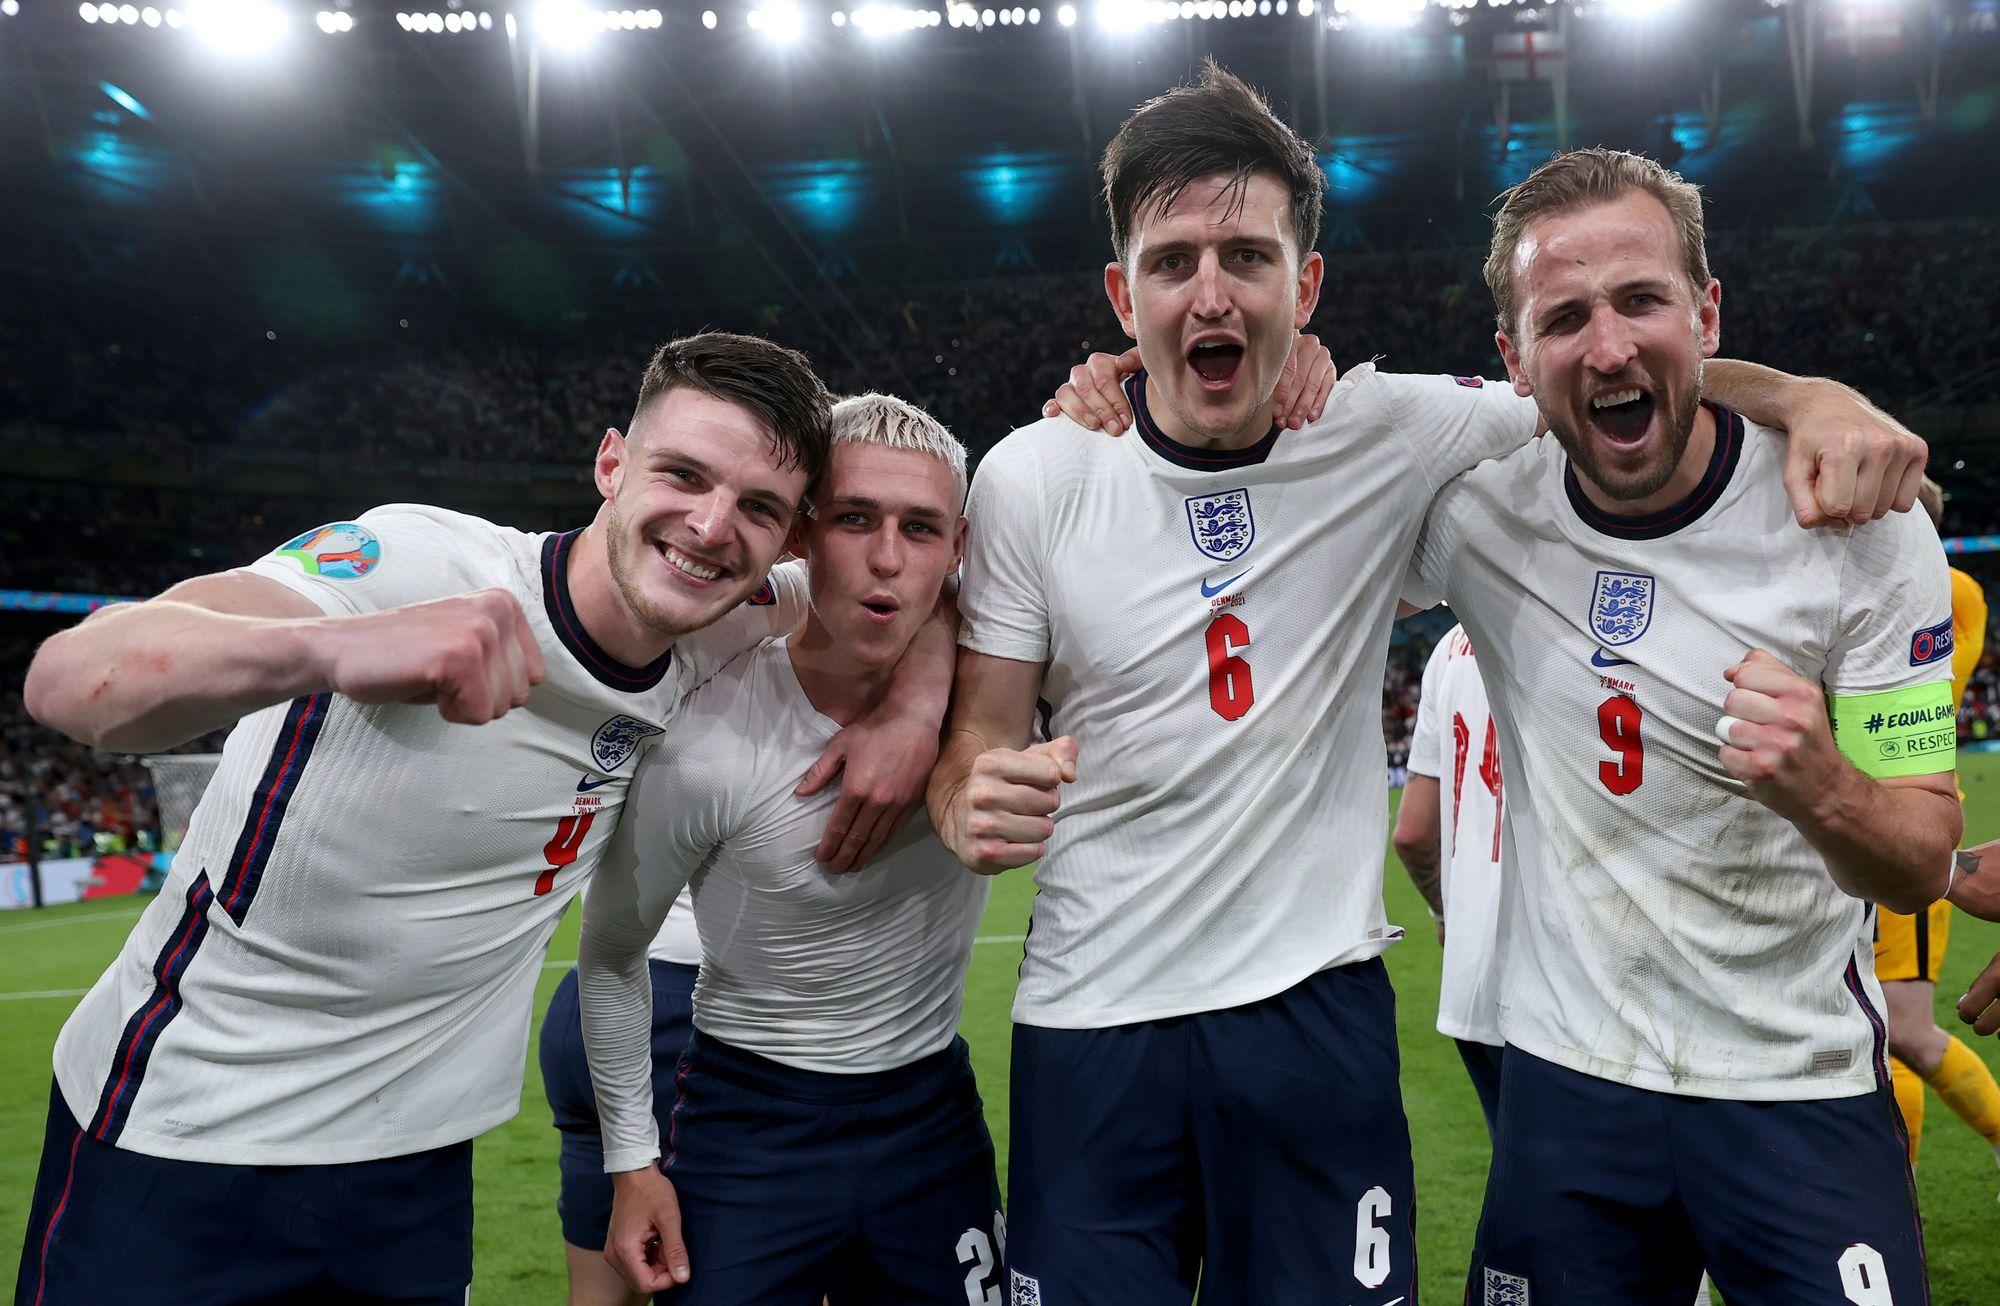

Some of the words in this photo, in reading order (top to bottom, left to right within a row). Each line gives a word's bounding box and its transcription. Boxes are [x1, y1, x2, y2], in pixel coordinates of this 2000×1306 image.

[1205, 613, 1255, 722] 6
[1597, 694, 1644, 796] 9
[1907, 731, 1955, 753] RESPECT
[534, 812, 597, 896] 4
[1353, 1185, 1392, 1289] 6
